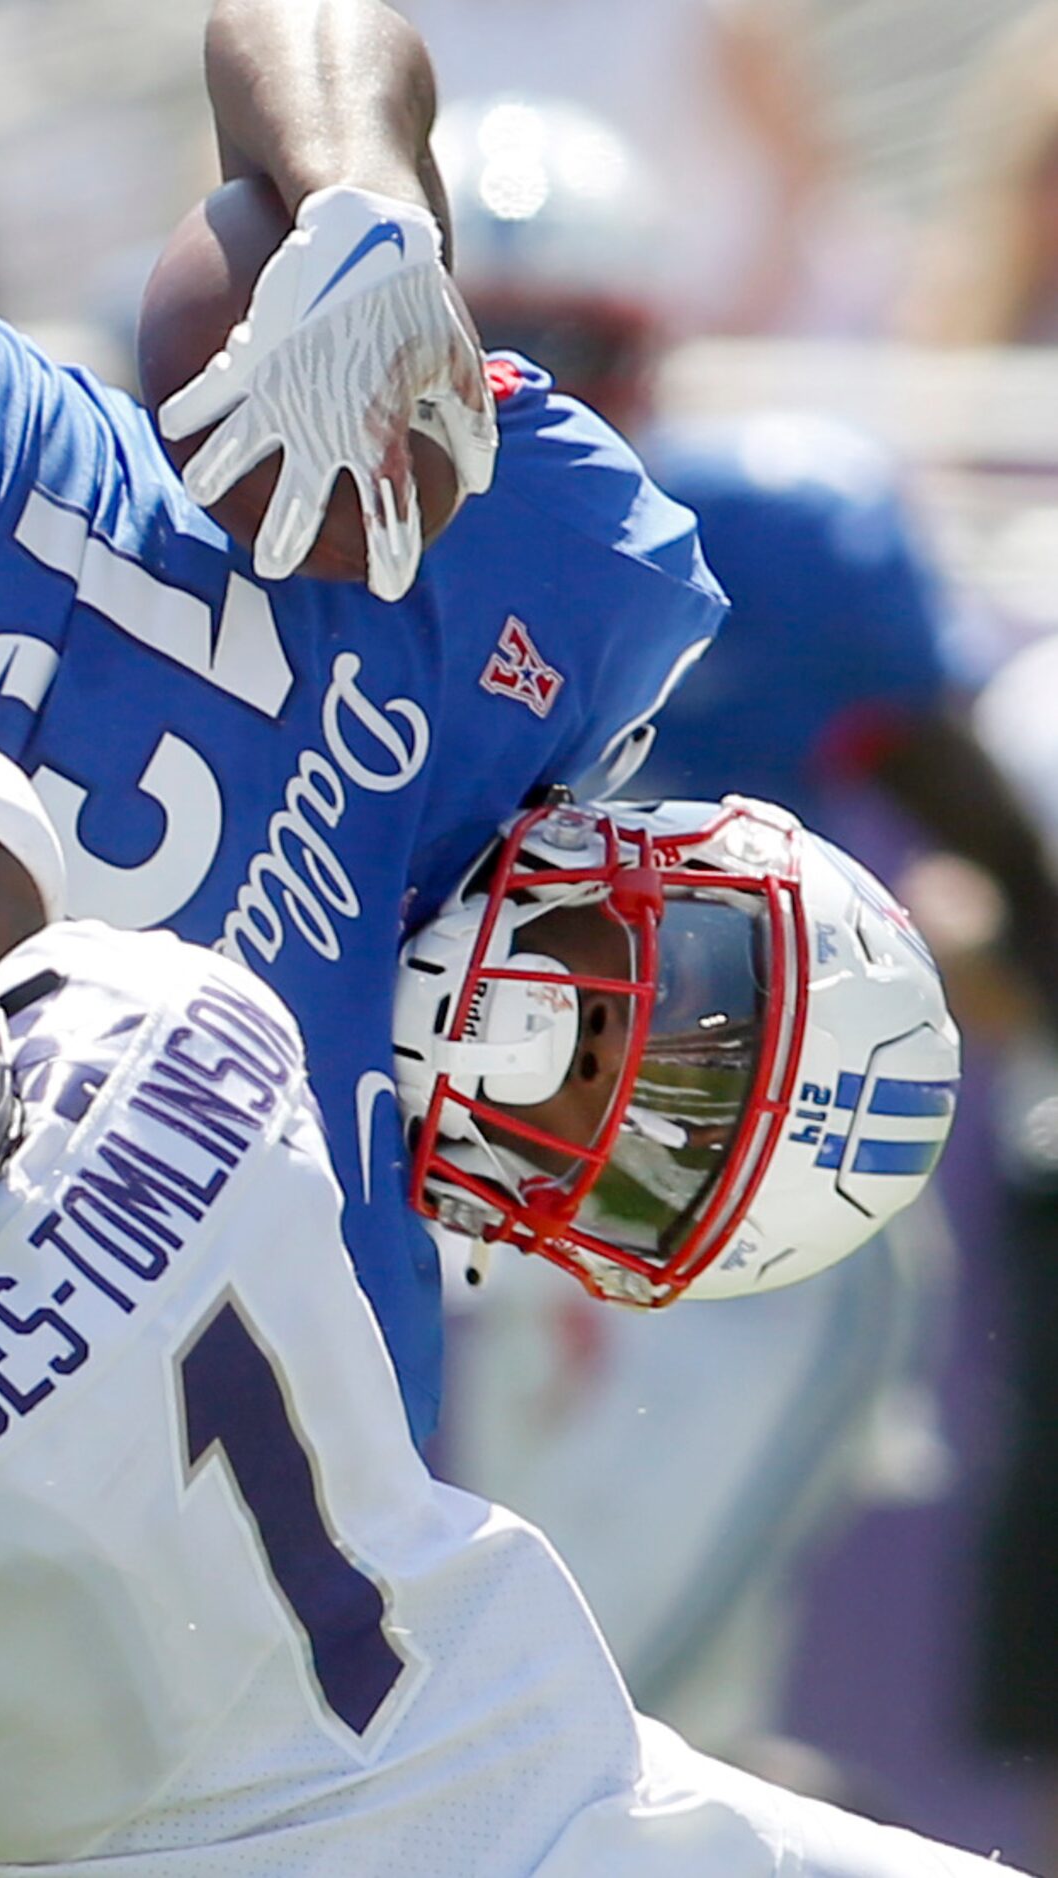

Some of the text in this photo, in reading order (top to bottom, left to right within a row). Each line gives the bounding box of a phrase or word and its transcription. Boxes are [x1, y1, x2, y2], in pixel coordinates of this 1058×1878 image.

[212, 652, 430, 967] Dalla
[788, 1081, 832, 1145] 214
[168, 1279, 422, 1760] 1
